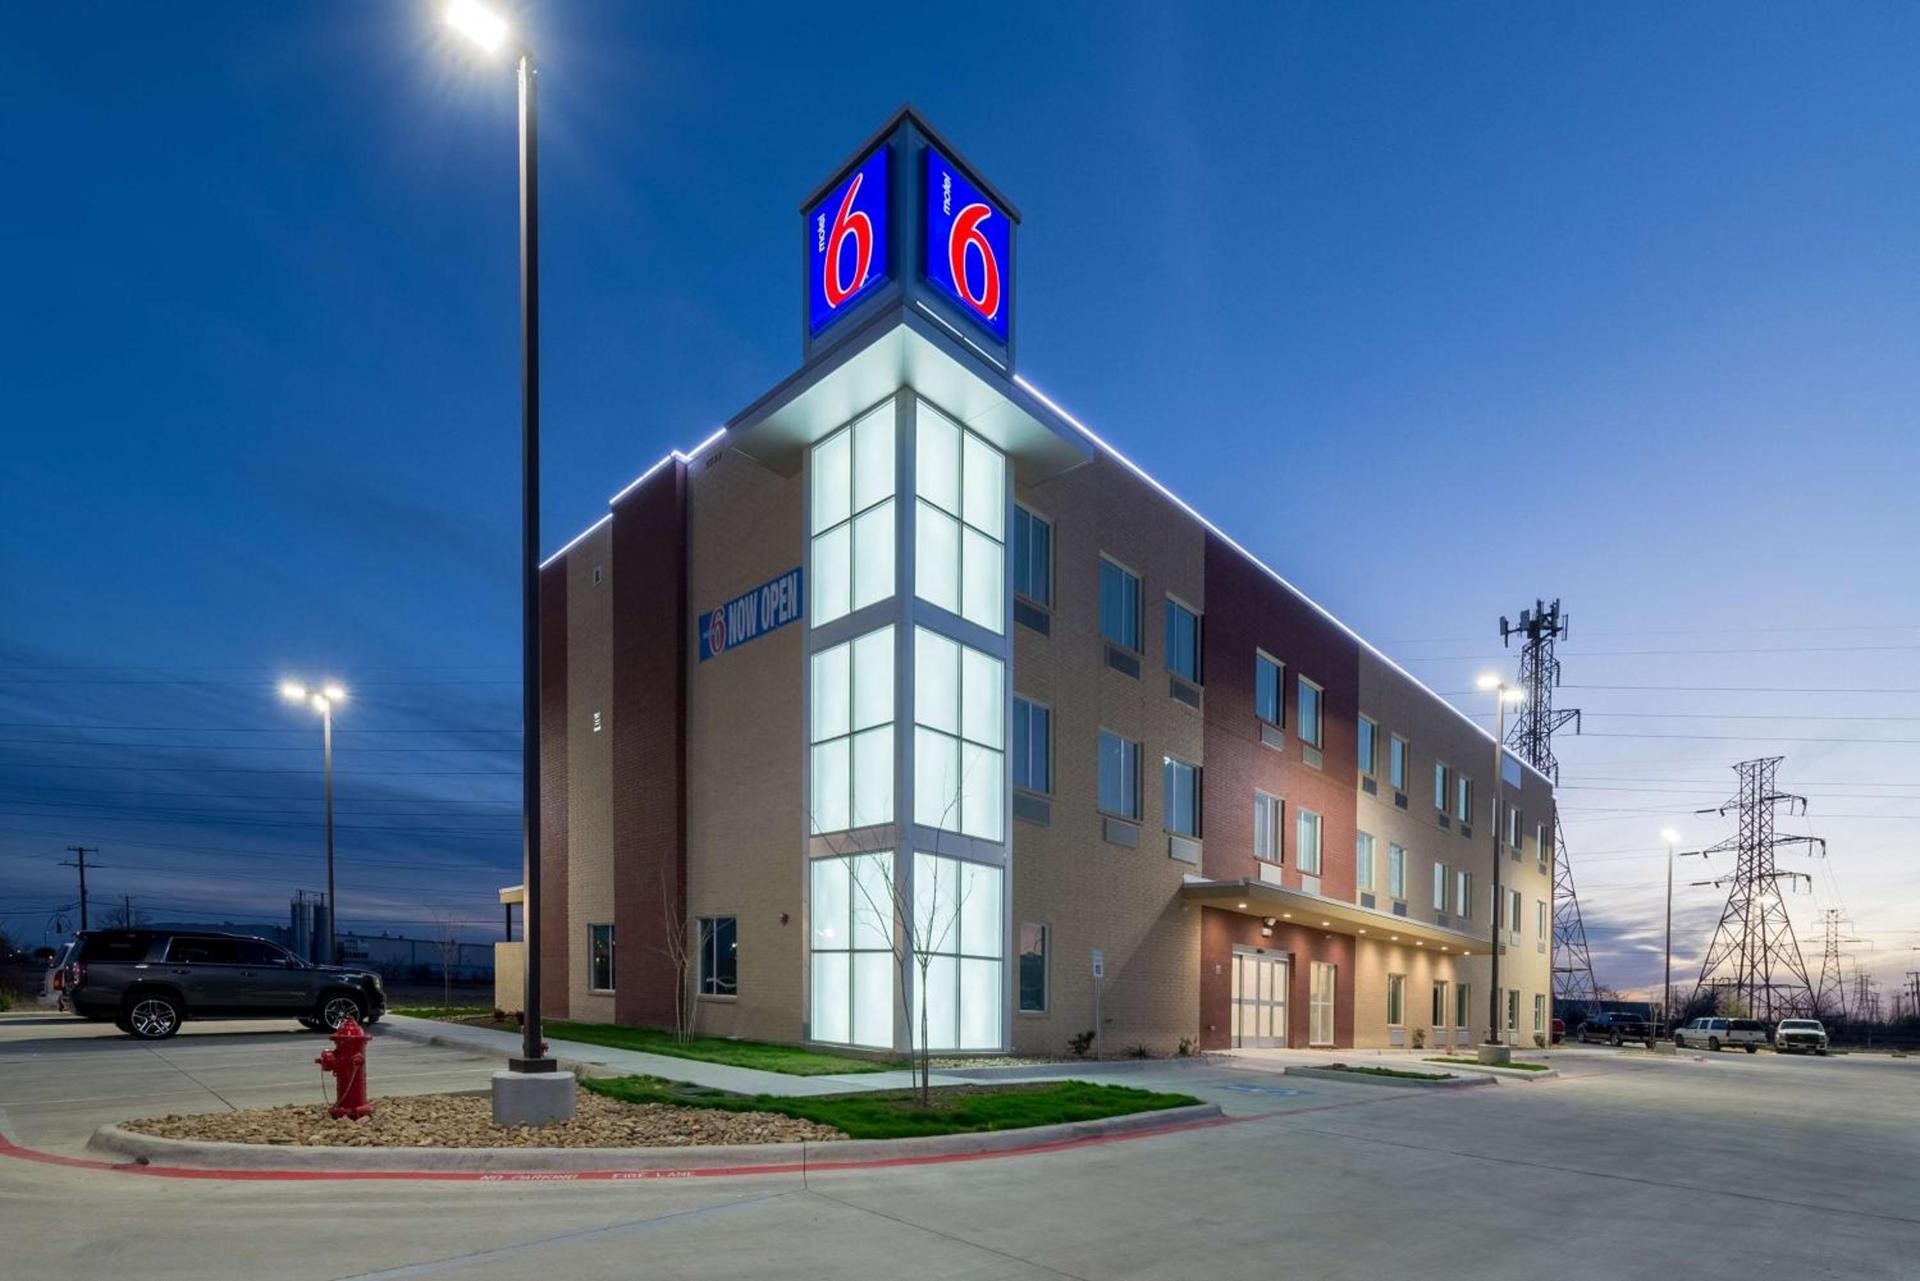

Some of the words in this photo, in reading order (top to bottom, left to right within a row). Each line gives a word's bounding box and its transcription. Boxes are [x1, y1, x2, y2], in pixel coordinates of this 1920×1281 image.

[818, 213, 826, 252] motel
[824, 173, 873, 309] 6
[943, 172, 953, 215] motel
[949, 203, 1000, 320] 6
[709, 606, 726, 655] 6
[728, 592, 758, 646] NOW
[761, 572, 797, 630] OPEN
